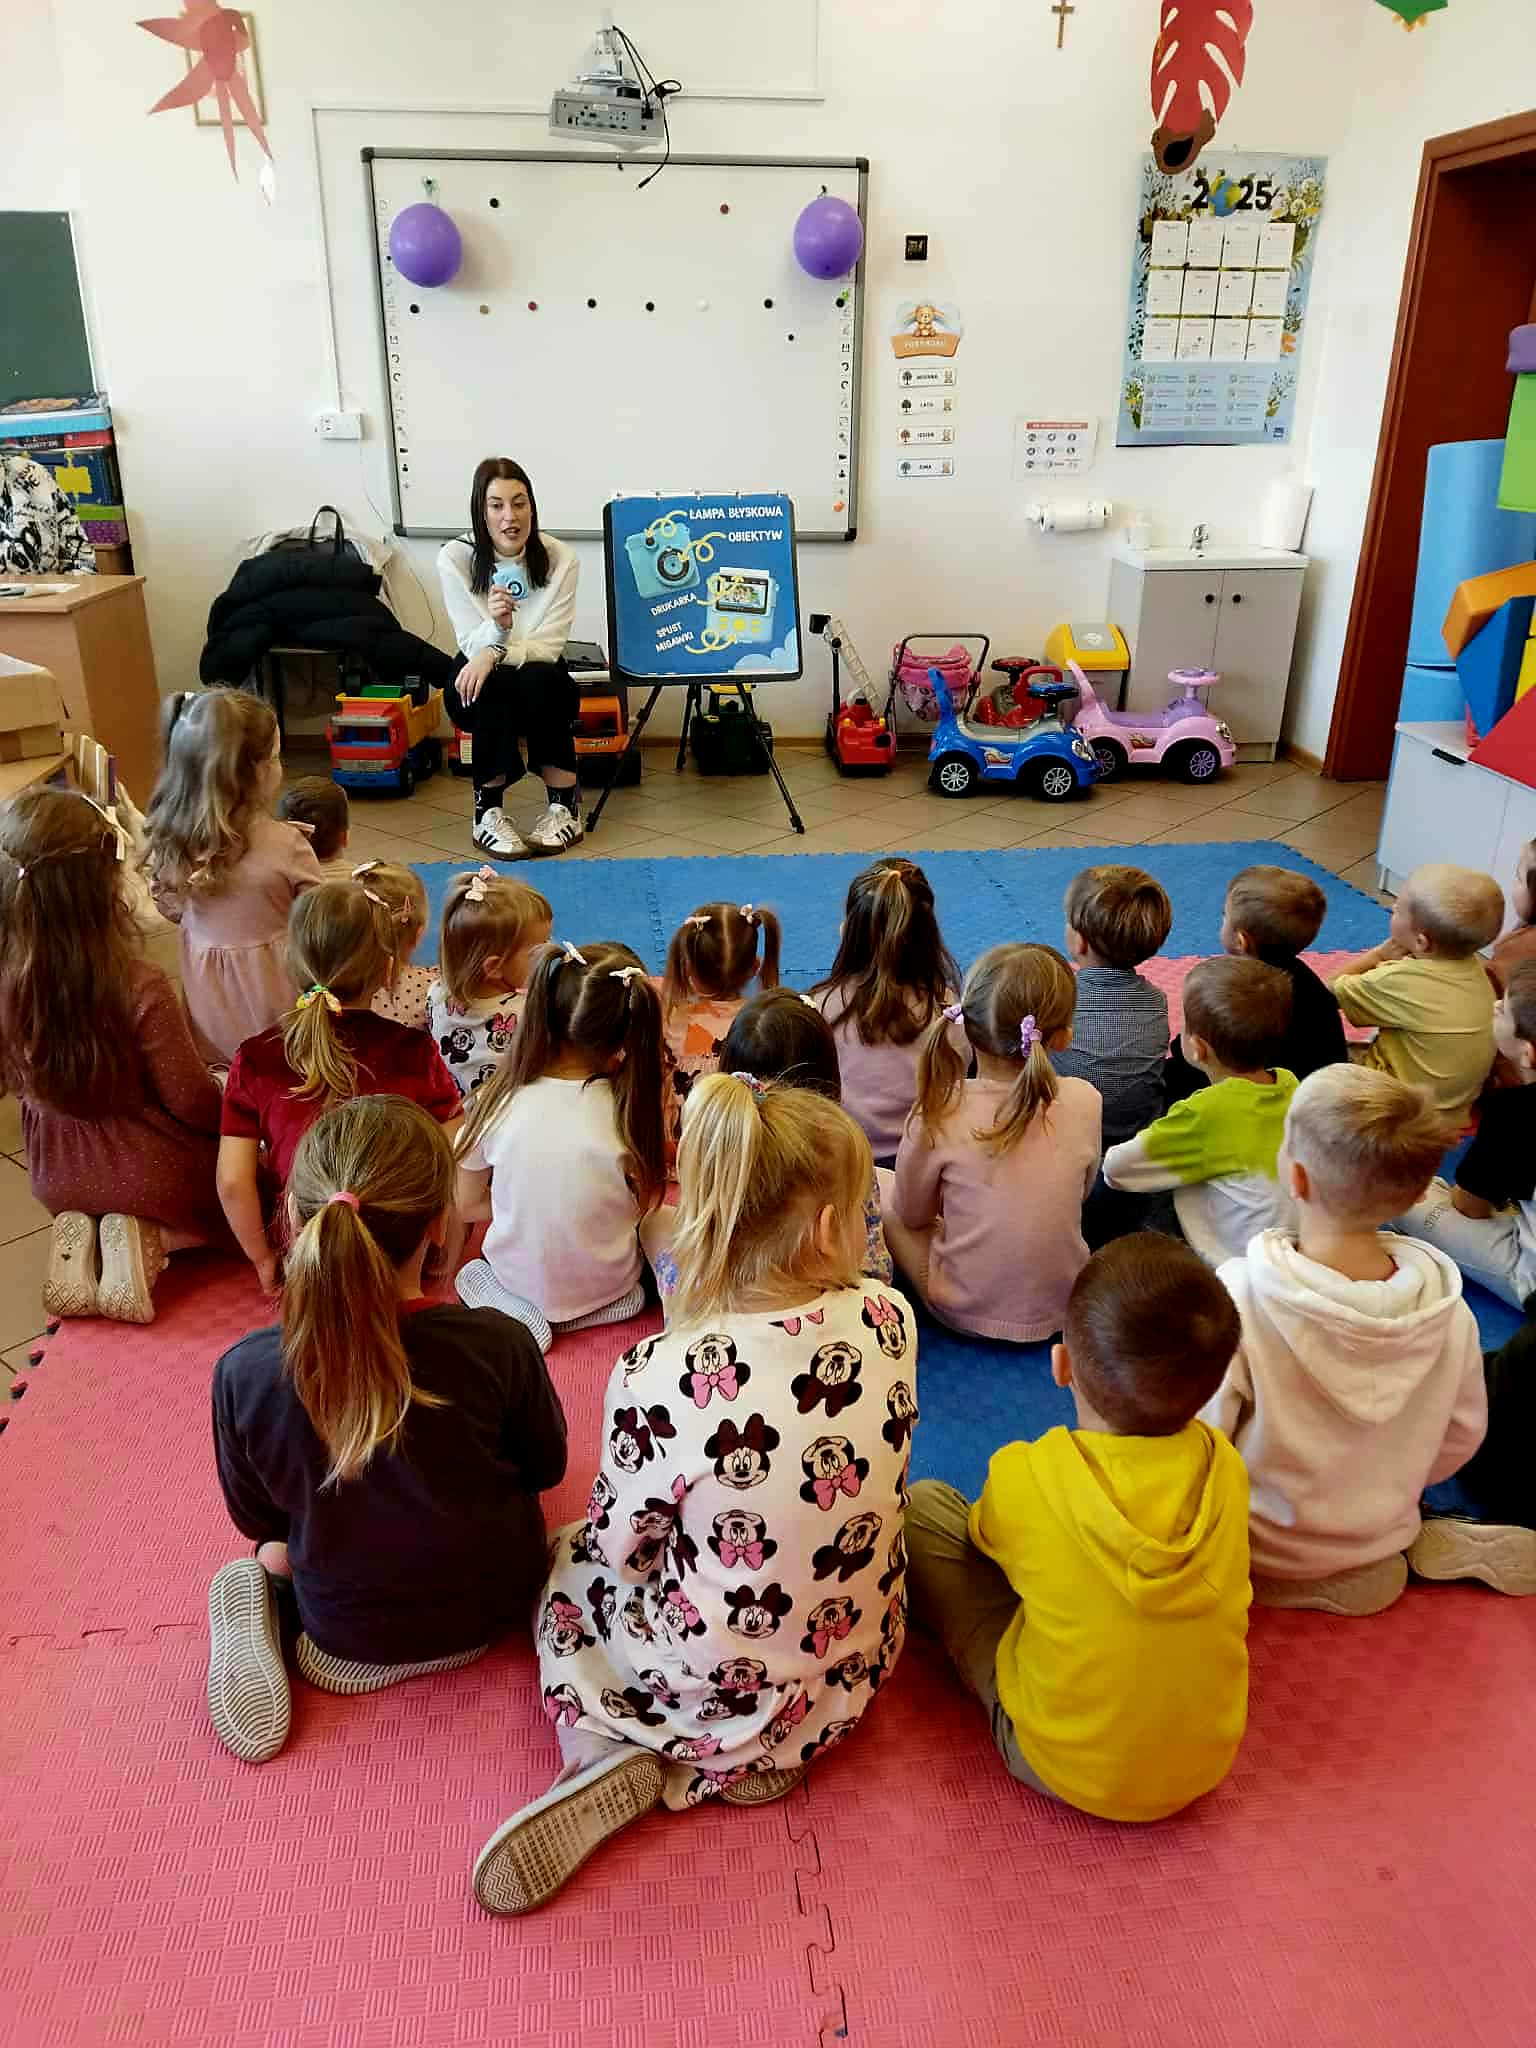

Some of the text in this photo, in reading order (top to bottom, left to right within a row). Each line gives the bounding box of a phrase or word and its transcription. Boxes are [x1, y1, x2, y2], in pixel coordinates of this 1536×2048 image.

[728, 505, 783, 519] BŁYSKOWA
[728, 529, 783, 543] OBIEKTYW
[650, 592, 697, 616] DRUKARKA
[656, 621, 682, 638] SPUST
[655, 631, 694, 653] MIGAWKI
